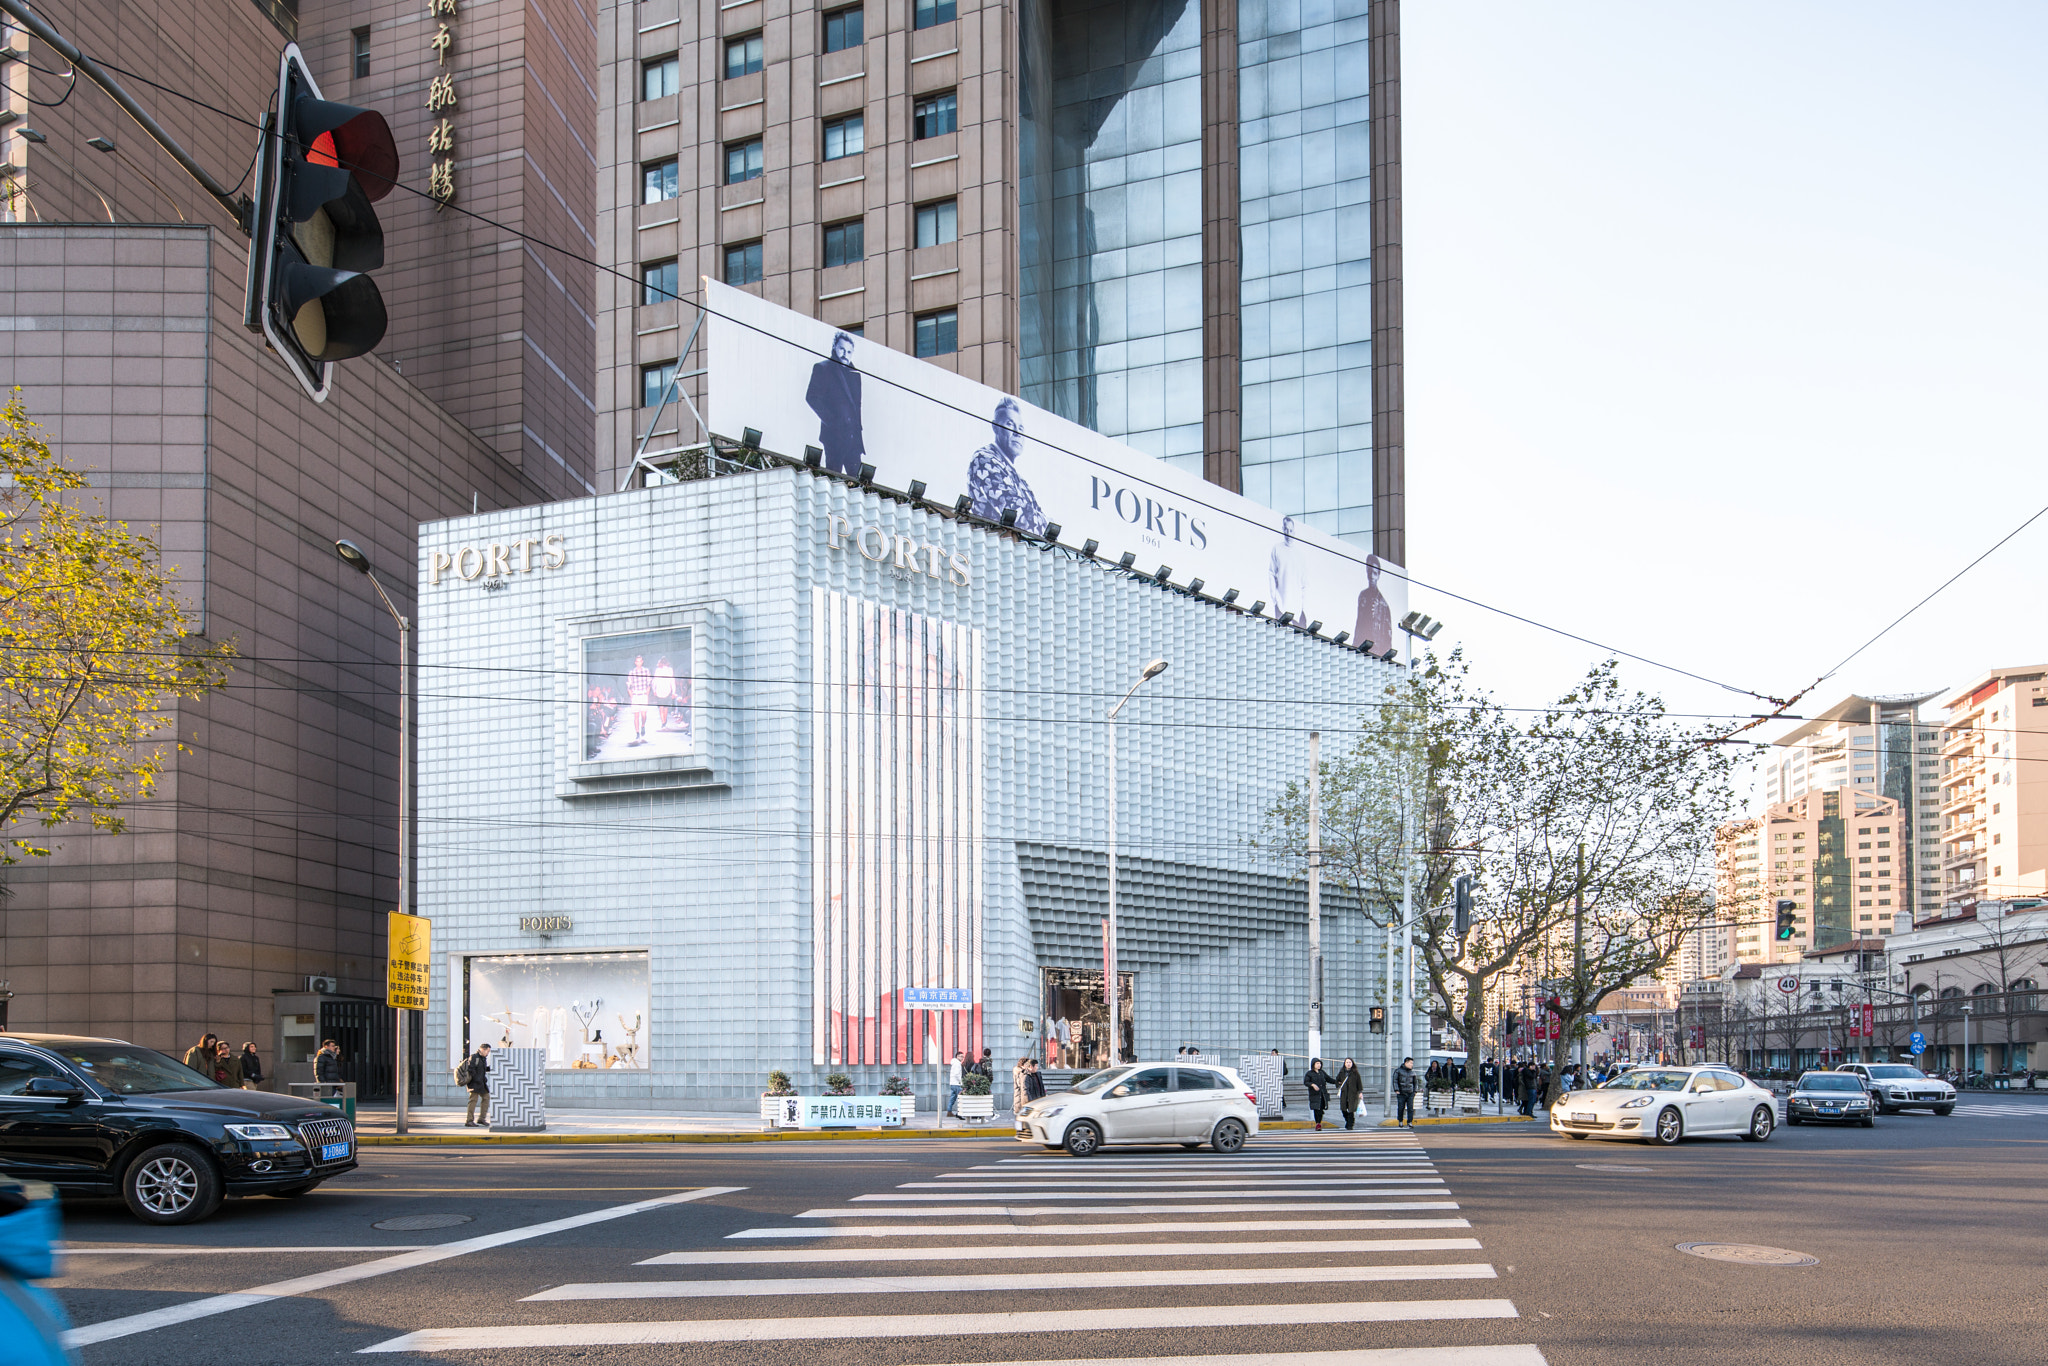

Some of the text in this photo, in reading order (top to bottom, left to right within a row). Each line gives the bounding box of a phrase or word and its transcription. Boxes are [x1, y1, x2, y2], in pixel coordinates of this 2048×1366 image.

[1091, 475, 1207, 550] PORTS
[1141, 534, 1161, 549] 1961
[828, 512, 971, 587] PORTS
[428, 534, 566, 585] PORTS
[520, 916, 573, 931] PORTS
[391, 959, 429, 973] 电子警察监管
[390, 982, 428, 996] 停车行为违法
[1782, 980, 1795, 988] 40
[393, 994, 425, 1007] 请立即驶离
[919, 990, 958, 1001] 南京西路
[1374, 1008, 1383, 1019] 13
[810, 1104, 883, 1119] 严禁行人乱穿马路
